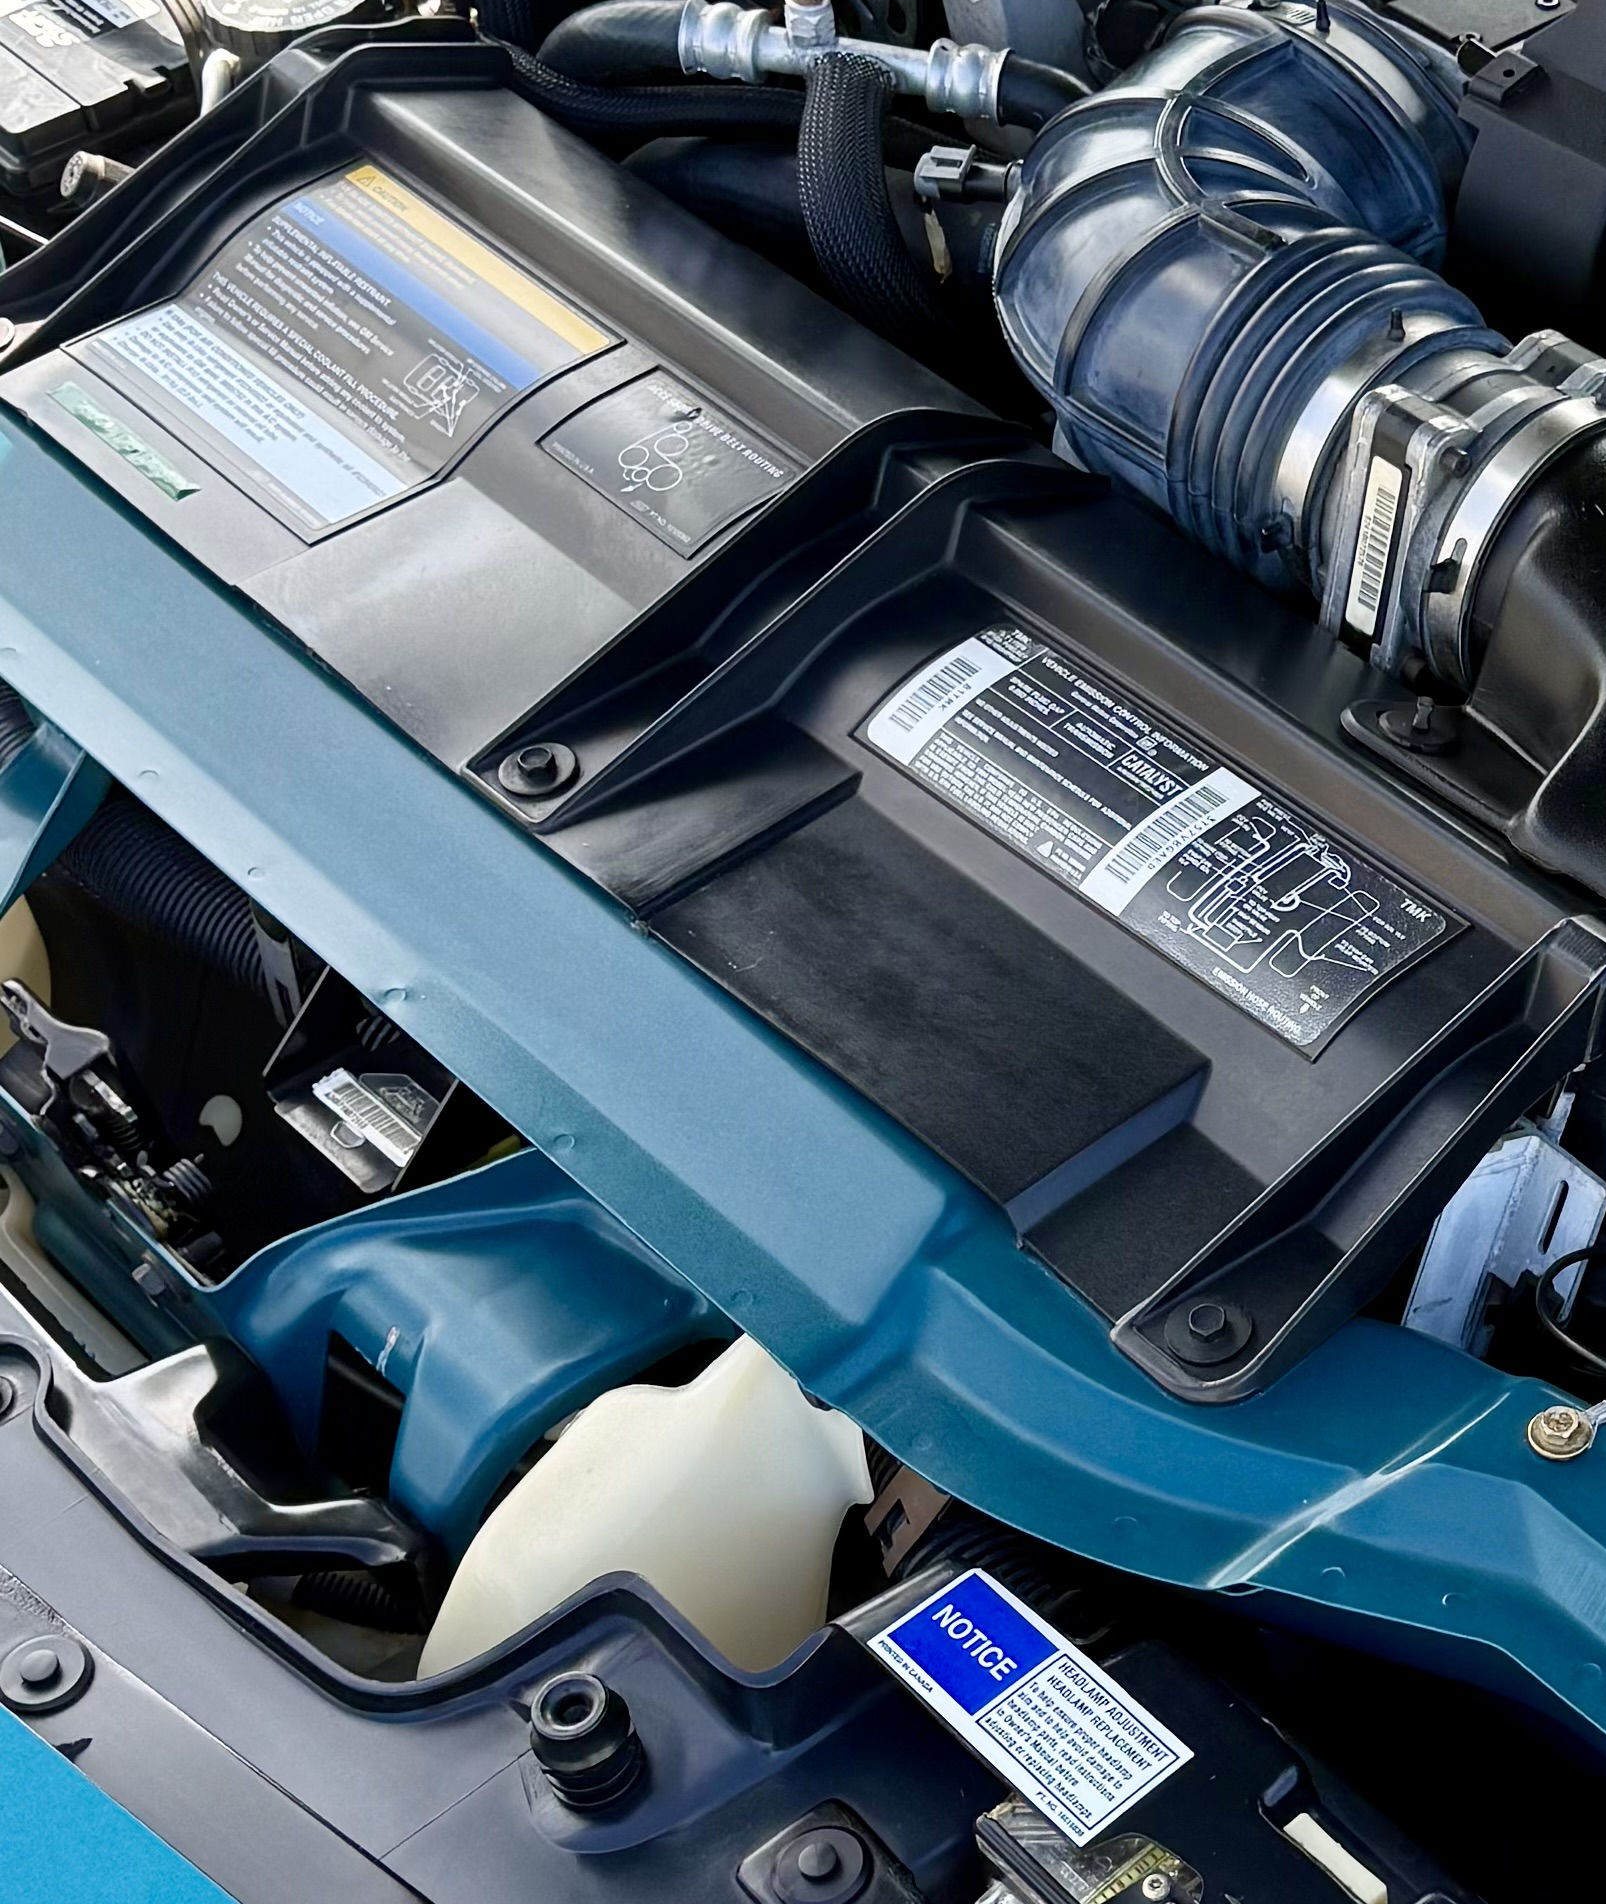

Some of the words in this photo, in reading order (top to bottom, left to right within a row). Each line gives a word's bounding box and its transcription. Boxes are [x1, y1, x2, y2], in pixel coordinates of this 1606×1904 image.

[718, 432, 746, 452] BELT
[739, 447, 785, 479] ROUTING
[1038, 655, 1077, 683] VEHICLE
[1072, 678, 1116, 709] EMISSION
[1110, 704, 1154, 735] CONTROL
[1149, 730, 1210, 772] INFORMATION
[1119, 752, 1185, 799] CATALYST
[1397, 897, 1432, 924] TMK
[1210, 965, 1250, 996] EMISSION
[1244, 990, 1271, 1012] HOSE
[1265, 1005, 1302, 1034] ROUTING
[928, 1603, 1021, 1682] NOTICE
[1001, 1713, 1034, 1743] Owner's
[1028, 1739, 1059, 1767] Manual
[1026, 1681, 1042, 1694] To
[1035, 1689, 1057, 1709] help
[1073, 1725, 1102, 1751] proper
[1029, 1702, 1047, 1719] and
[1042, 1715, 1055, 1726] to
[1049, 1722, 1071, 1740] help
[1065, 1736, 1090, 1758] avoid
[1110, 1778, 1125, 1791] to
[1045, 1674, 1095, 1718] HEADLAMP
[1088, 1714, 1153, 1772] REPLACEMENT
[1056, 1661, 1111, 1709] HEADLAMP
[1104, 1704, 1170, 1763] ADJUSTMENT
